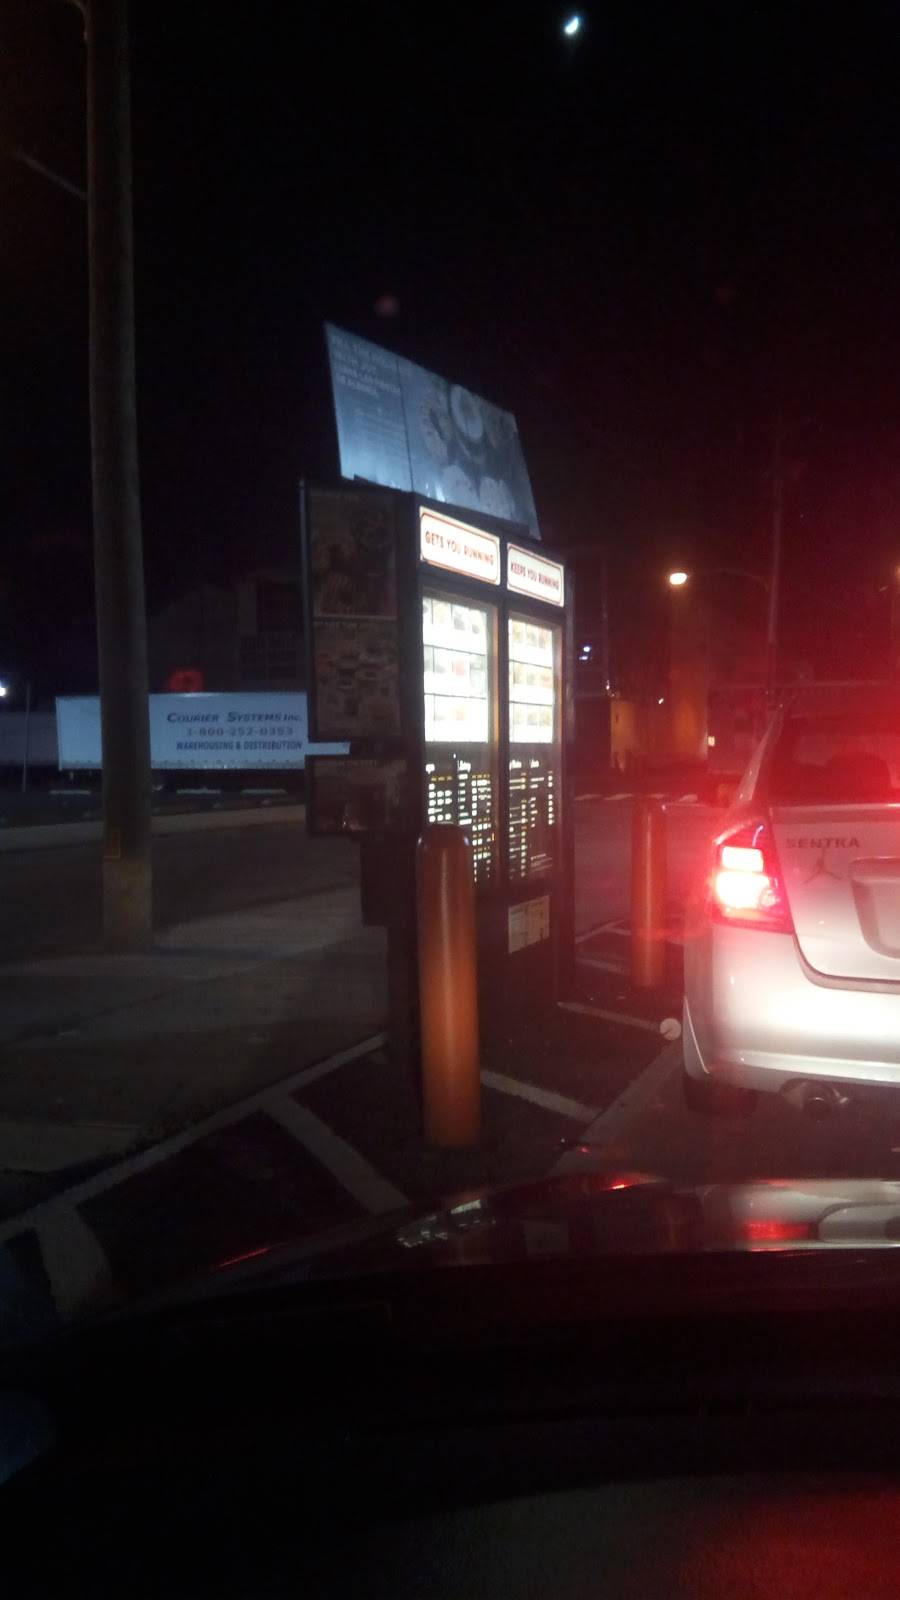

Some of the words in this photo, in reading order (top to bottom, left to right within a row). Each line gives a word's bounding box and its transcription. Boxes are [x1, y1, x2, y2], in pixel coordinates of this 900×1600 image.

[424, 530, 444, 548] GETS
[446, 538, 461, 554] YOU
[176, 741, 233, 751] WAREHOUSING
[243, 740, 303, 750] DISTRIBUTION
[785, 837, 862, 849] SENTRA
